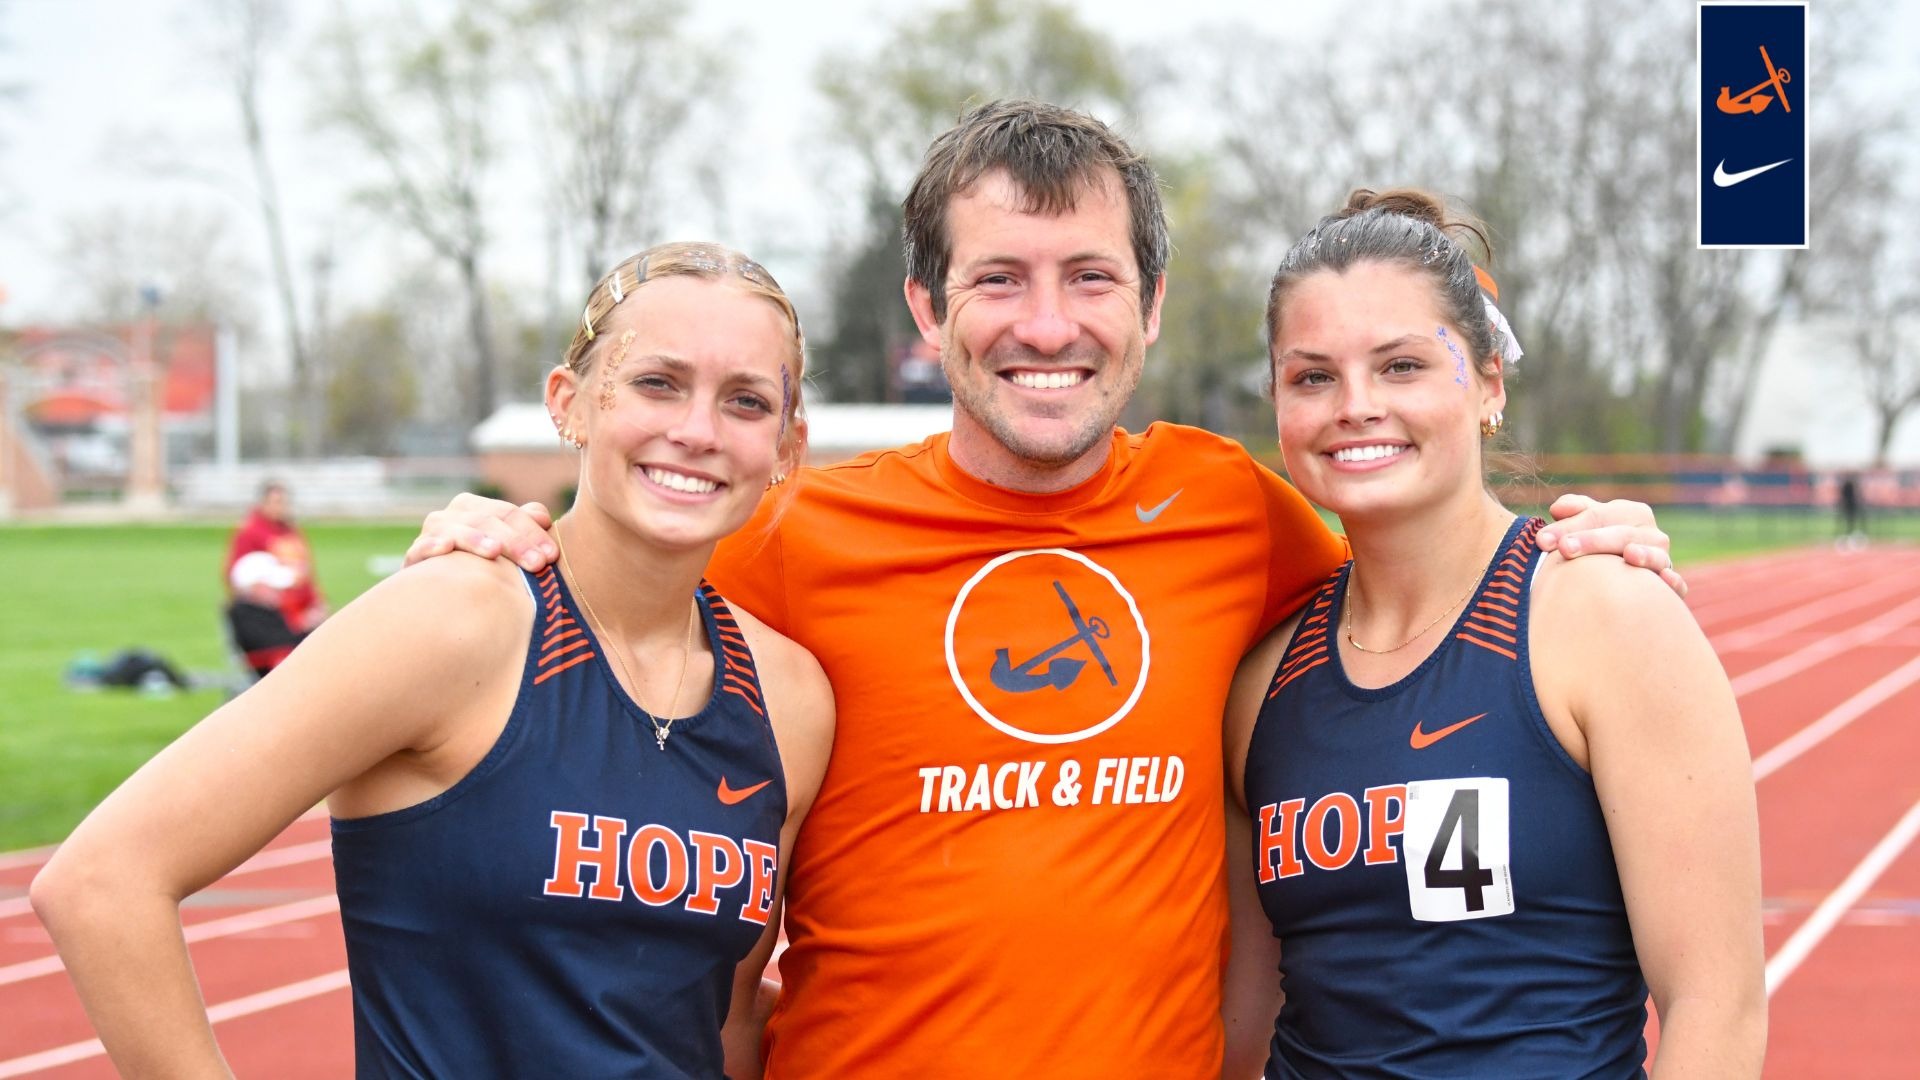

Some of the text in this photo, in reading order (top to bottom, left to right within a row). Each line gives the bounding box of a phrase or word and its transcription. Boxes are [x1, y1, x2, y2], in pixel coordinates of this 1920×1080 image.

[918, 756, 1184, 812] TRACK & FIELD
[543, 810, 777, 926] HOPE
[1424, 788, 1494, 912] 4
